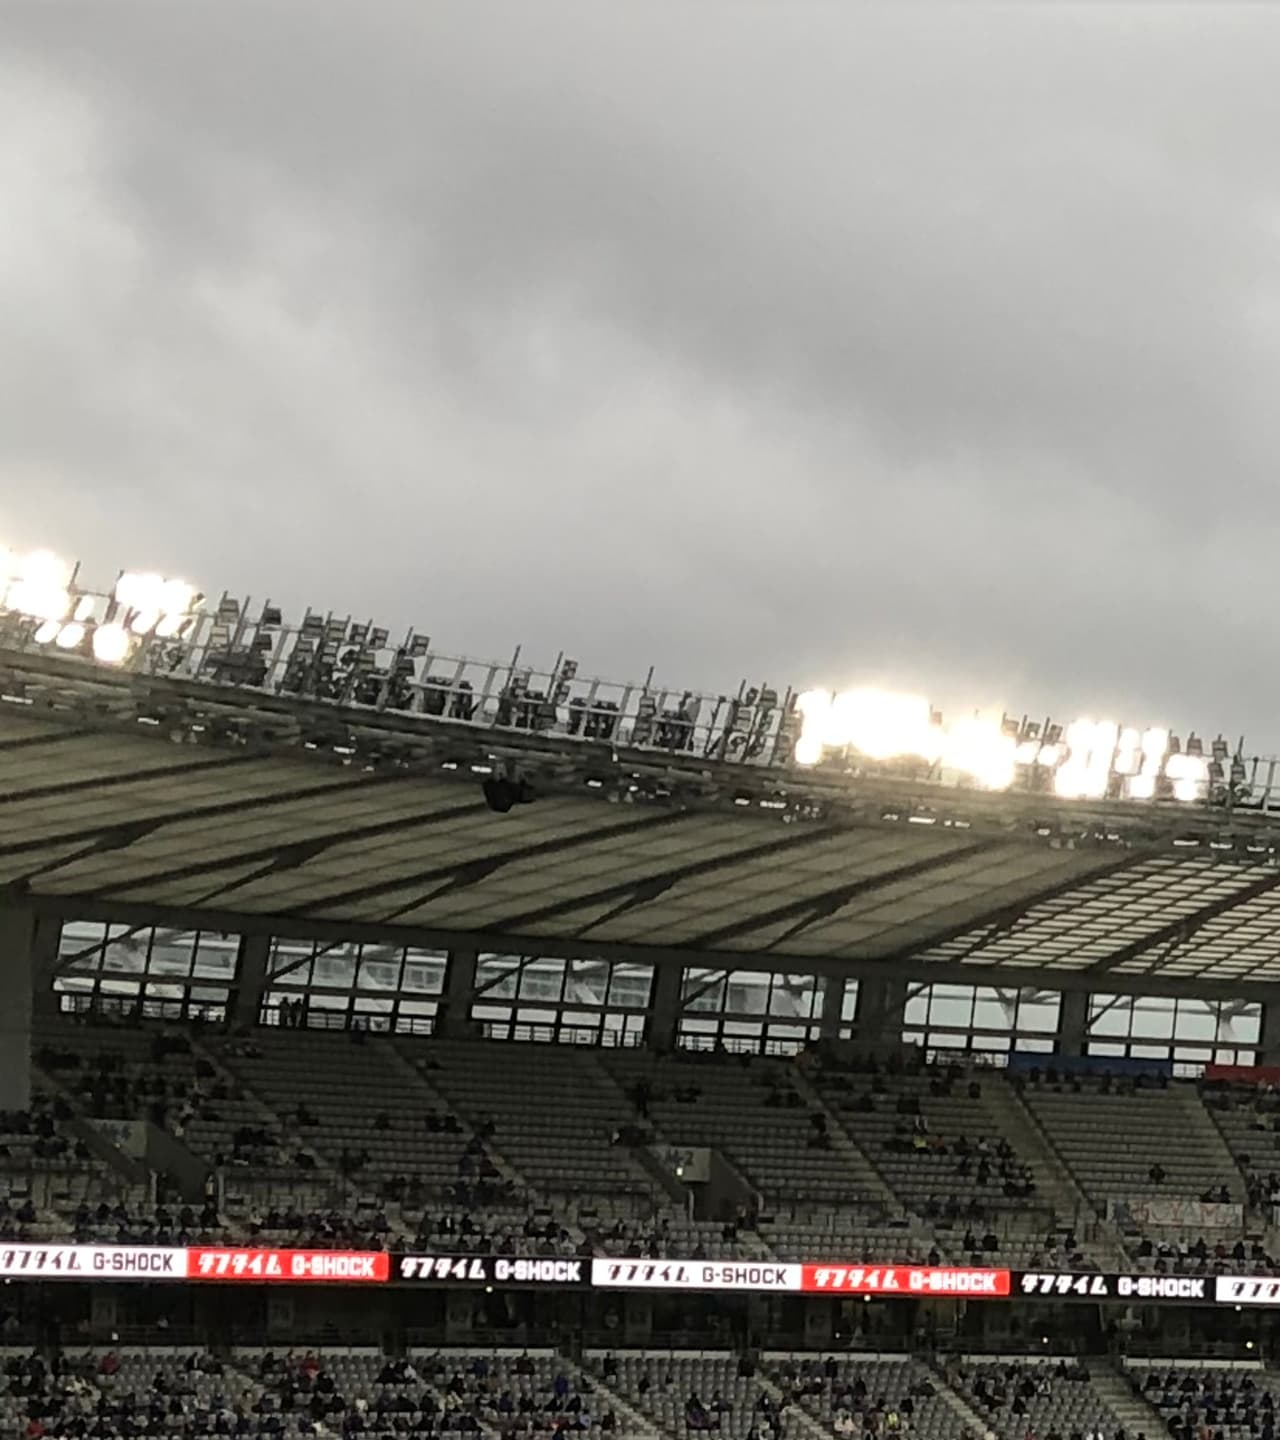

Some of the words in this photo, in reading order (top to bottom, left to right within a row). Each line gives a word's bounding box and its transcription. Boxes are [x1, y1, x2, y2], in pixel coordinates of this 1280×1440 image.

[94, 1253, 173, 1271] G-SHOCK
[198, 1253, 282, 1274] タフタイム
[291, 1255, 375, 1276] G-SHOCK
[400, 1257, 485, 1279] タフタイム
[495, 1259, 581, 1281] G-SHOCK
[608, 1263, 689, 1282] タフタイム
[702, 1266, 787, 1284] G-SHOCK
[814, 1268, 899, 1289] タフタイム
[909, 1270, 996, 1292] G-SHOCK
[1021, 1273, 1107, 1295] タフタイム
[1117, 1276, 1204, 1298] G-SHOCK
